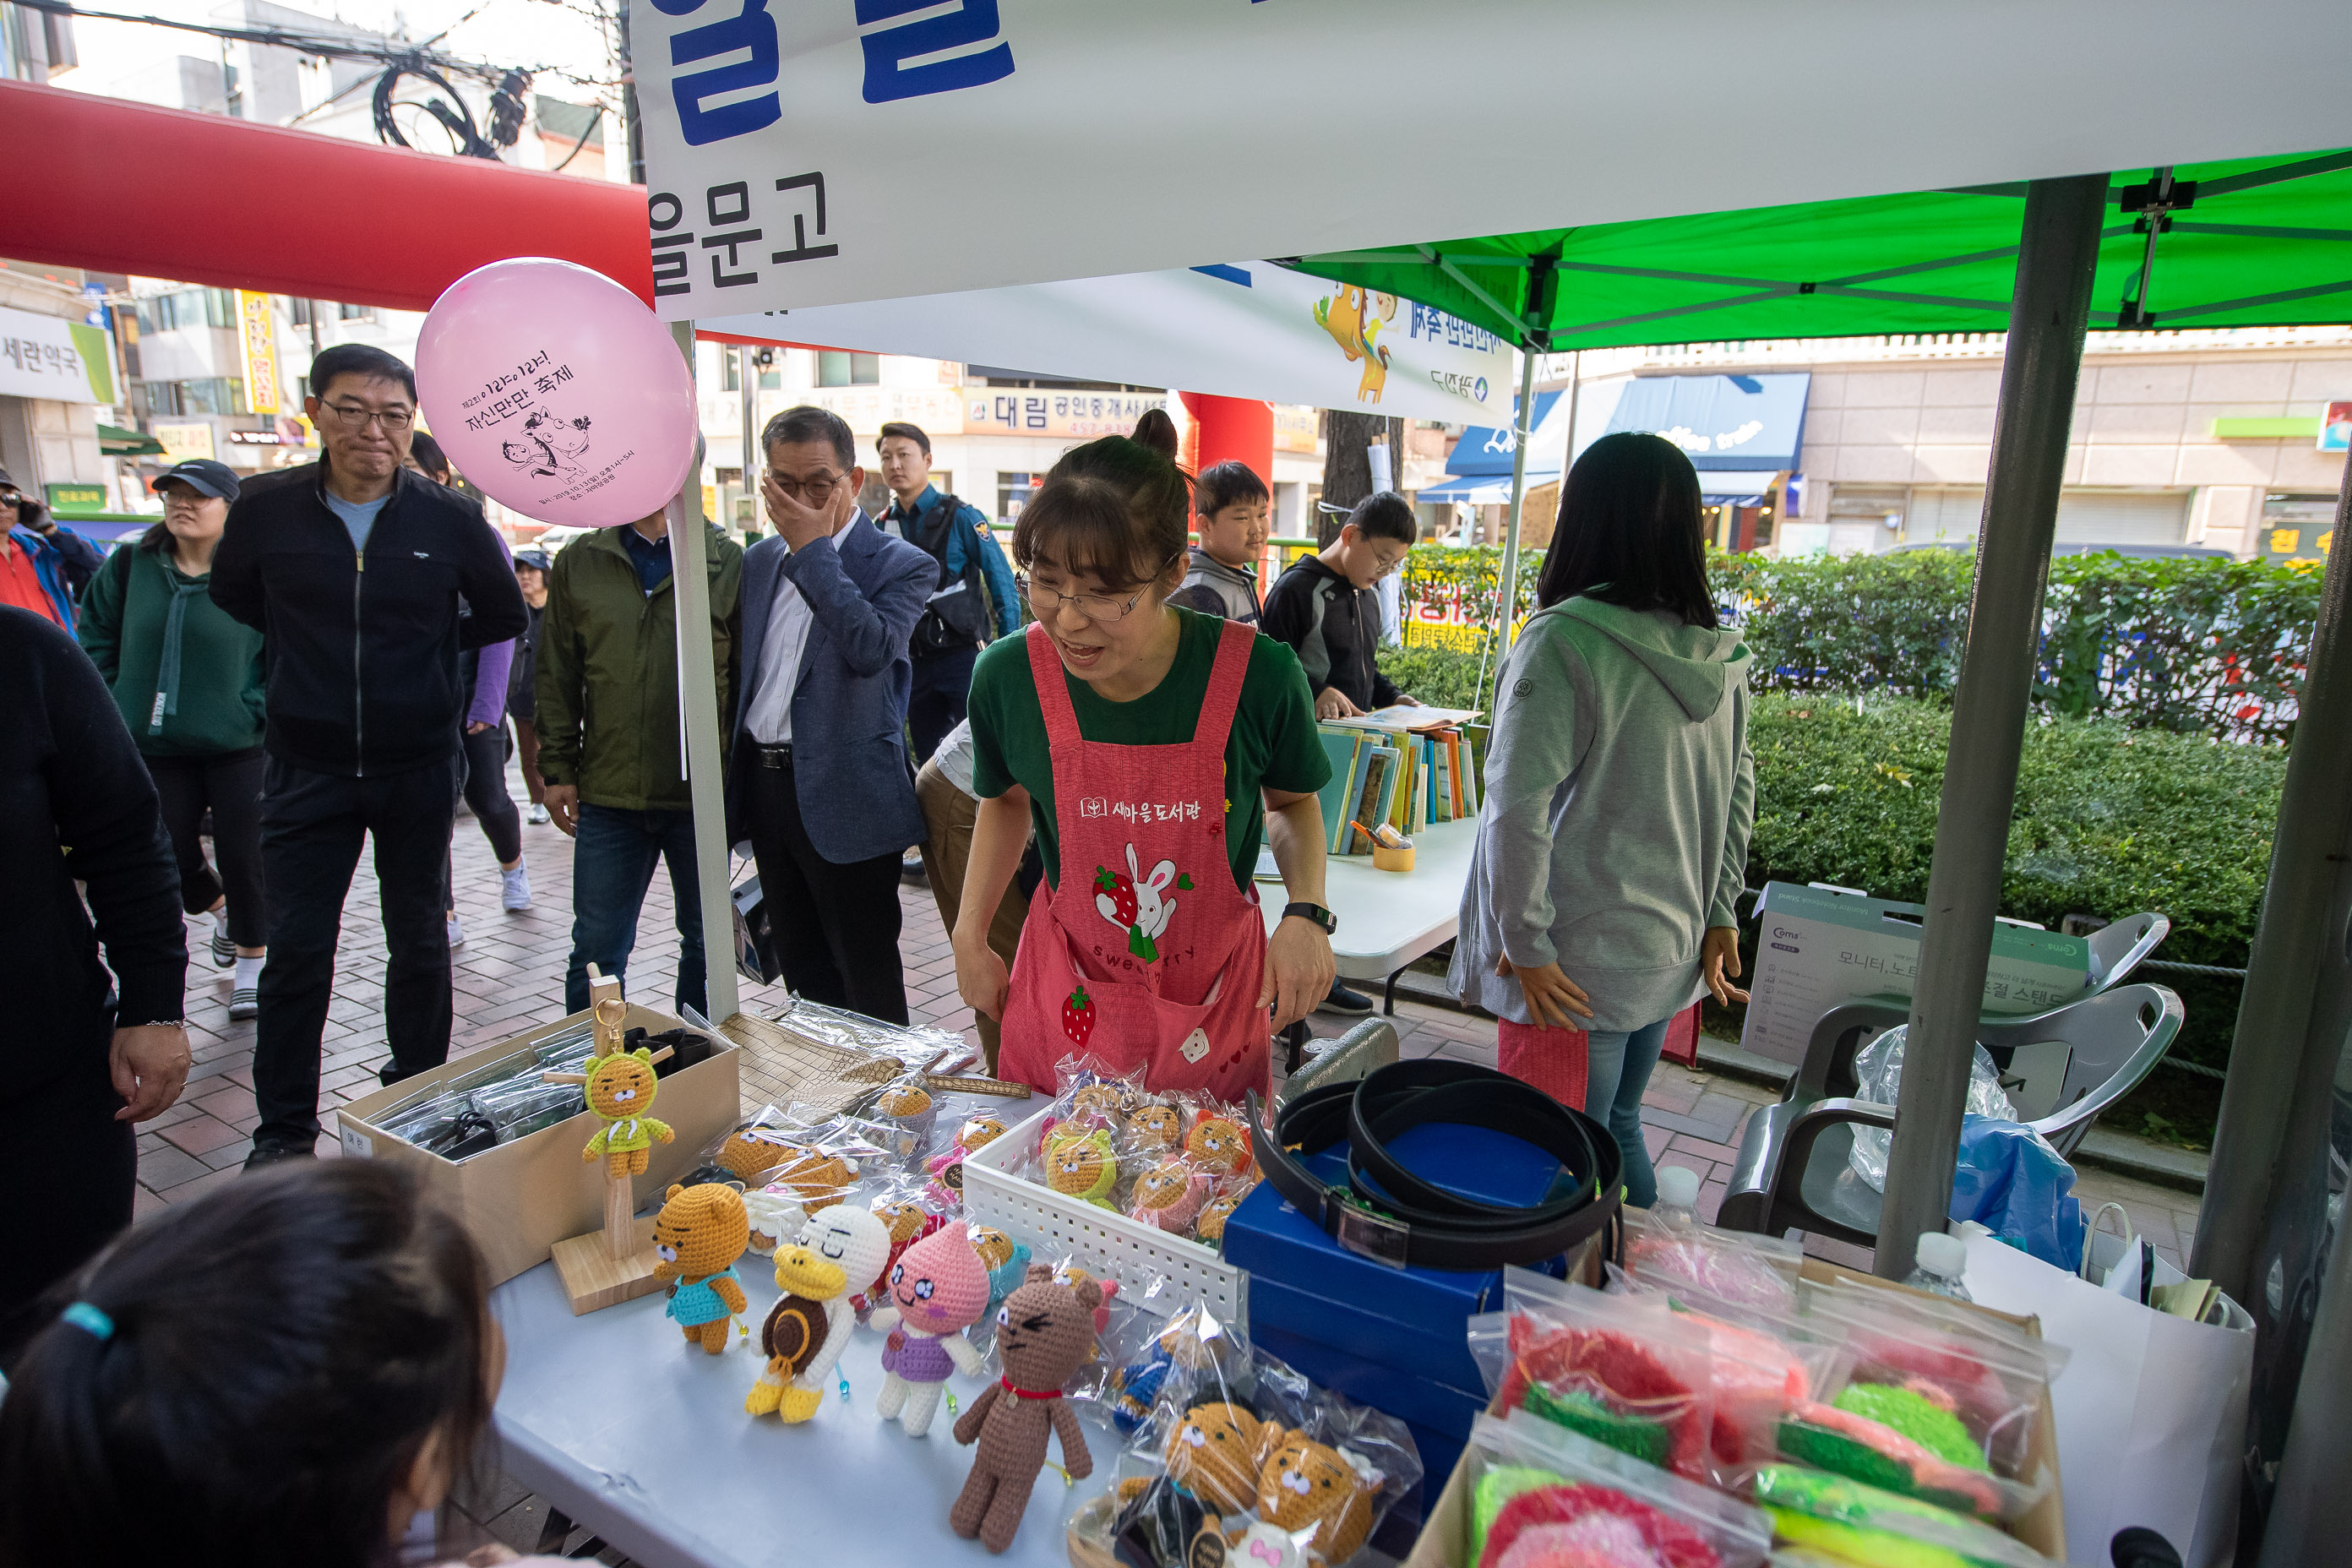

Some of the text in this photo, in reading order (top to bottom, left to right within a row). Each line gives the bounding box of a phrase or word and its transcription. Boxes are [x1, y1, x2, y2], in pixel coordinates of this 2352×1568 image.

[648, 171, 839, 297] 을문고
[3, 337, 79, 378] 세란약국
[461, 395, 482, 409] 제2회
[465, 364, 574, 432] 자신만만 축제
[995, 396, 1047, 428] 대림
[1778, 892, 1869, 916] Monitor Notebook Stand
[1773, 927, 1799, 939] Coms
[2048, 943, 2077, 956] Coms
[2012, 988, 2064, 1006] 스탠드
